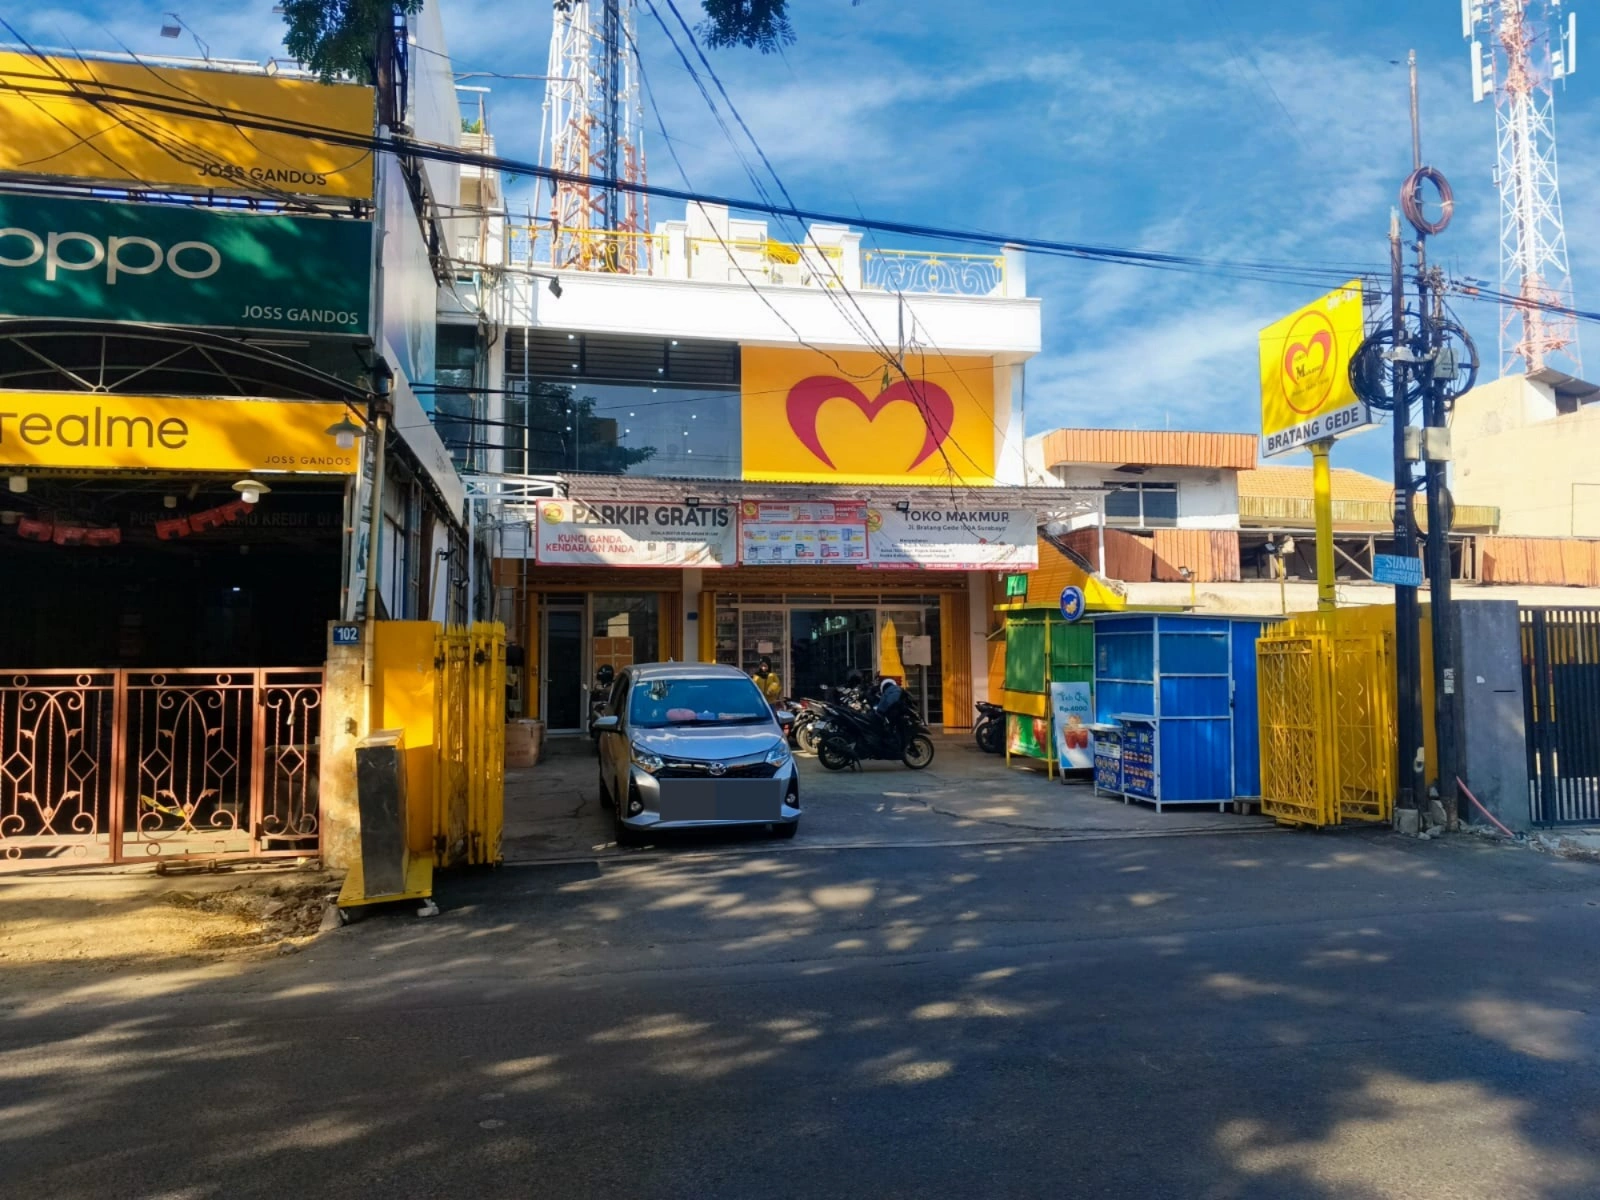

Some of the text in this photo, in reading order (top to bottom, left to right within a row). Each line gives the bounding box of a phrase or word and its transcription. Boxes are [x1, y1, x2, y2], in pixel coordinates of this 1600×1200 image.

[198, 163, 327, 186] JOSS GANDOS
[241, 305, 359, 325] JOSS GANDOS
[0, 406, 189, 449] realme
[1267, 406, 1359, 451] BRATANG GEDE
[264, 455, 351, 466] JOSS GANDOS
[572, 505, 729, 527] PARKIR GRATIS
[904, 510, 942, 522] TOKO
[558, 534, 622, 544] KUNCI GANDA
[546, 543, 635, 553] KENDARAAN ANDA
[338, 628, 357, 640] 102
